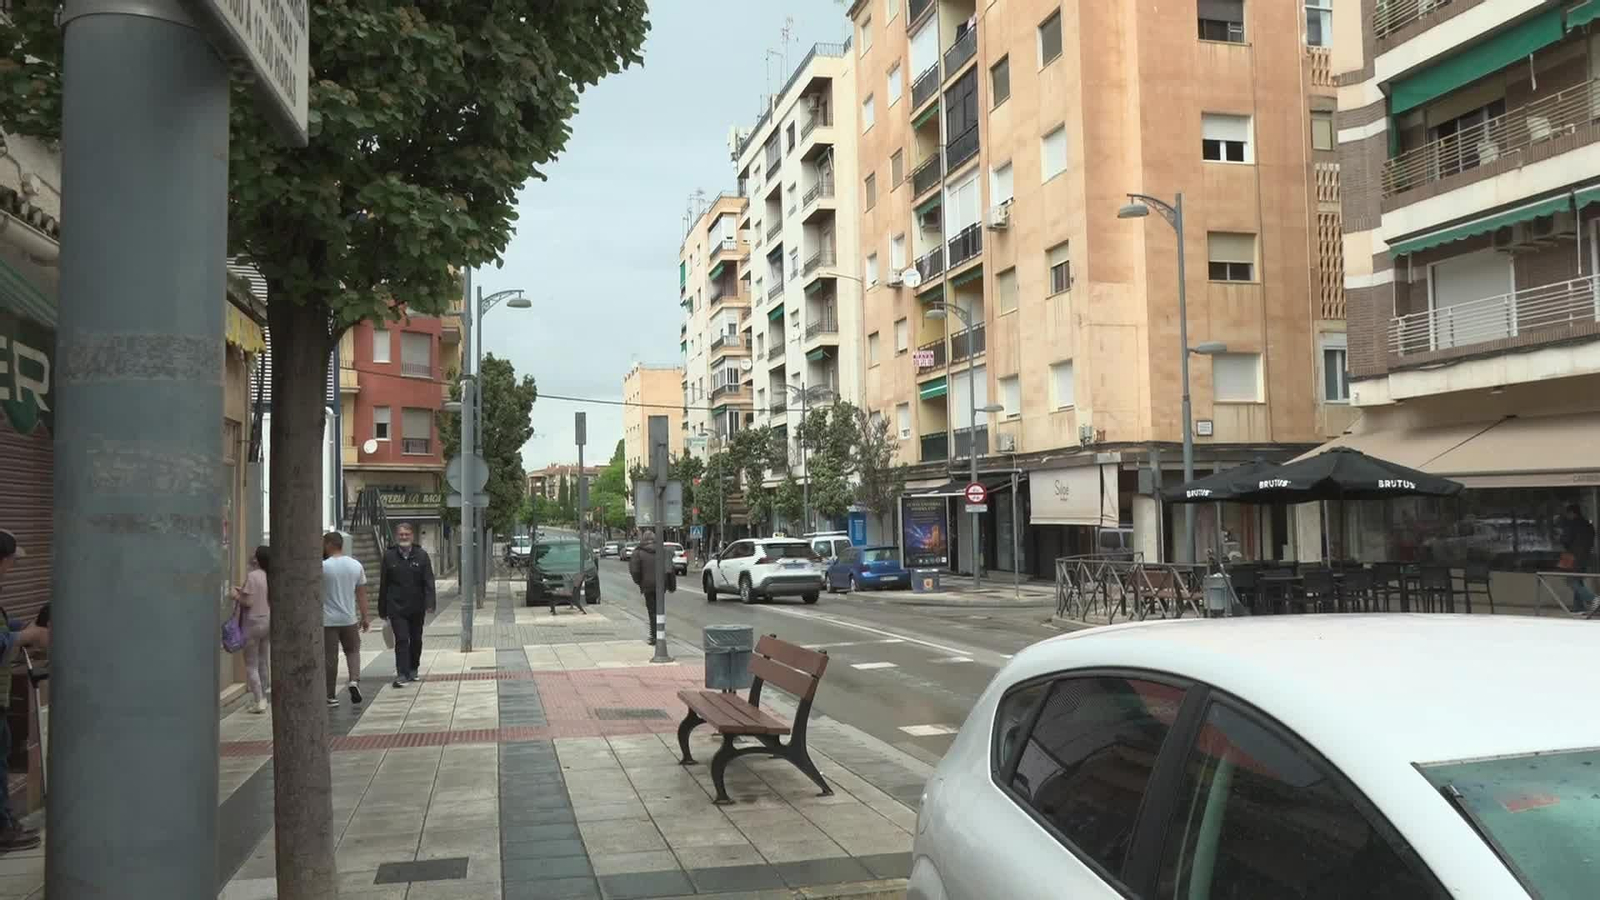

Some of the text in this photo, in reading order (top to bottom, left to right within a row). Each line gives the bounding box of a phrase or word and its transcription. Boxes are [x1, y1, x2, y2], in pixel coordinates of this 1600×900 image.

[275, 43, 297, 107] HORAS
[1259, 479, 1288, 489] BRUTUS
[1378, 479, 1417, 489] BRUTUS
[1186, 489, 1210, 498] BRUTUS
